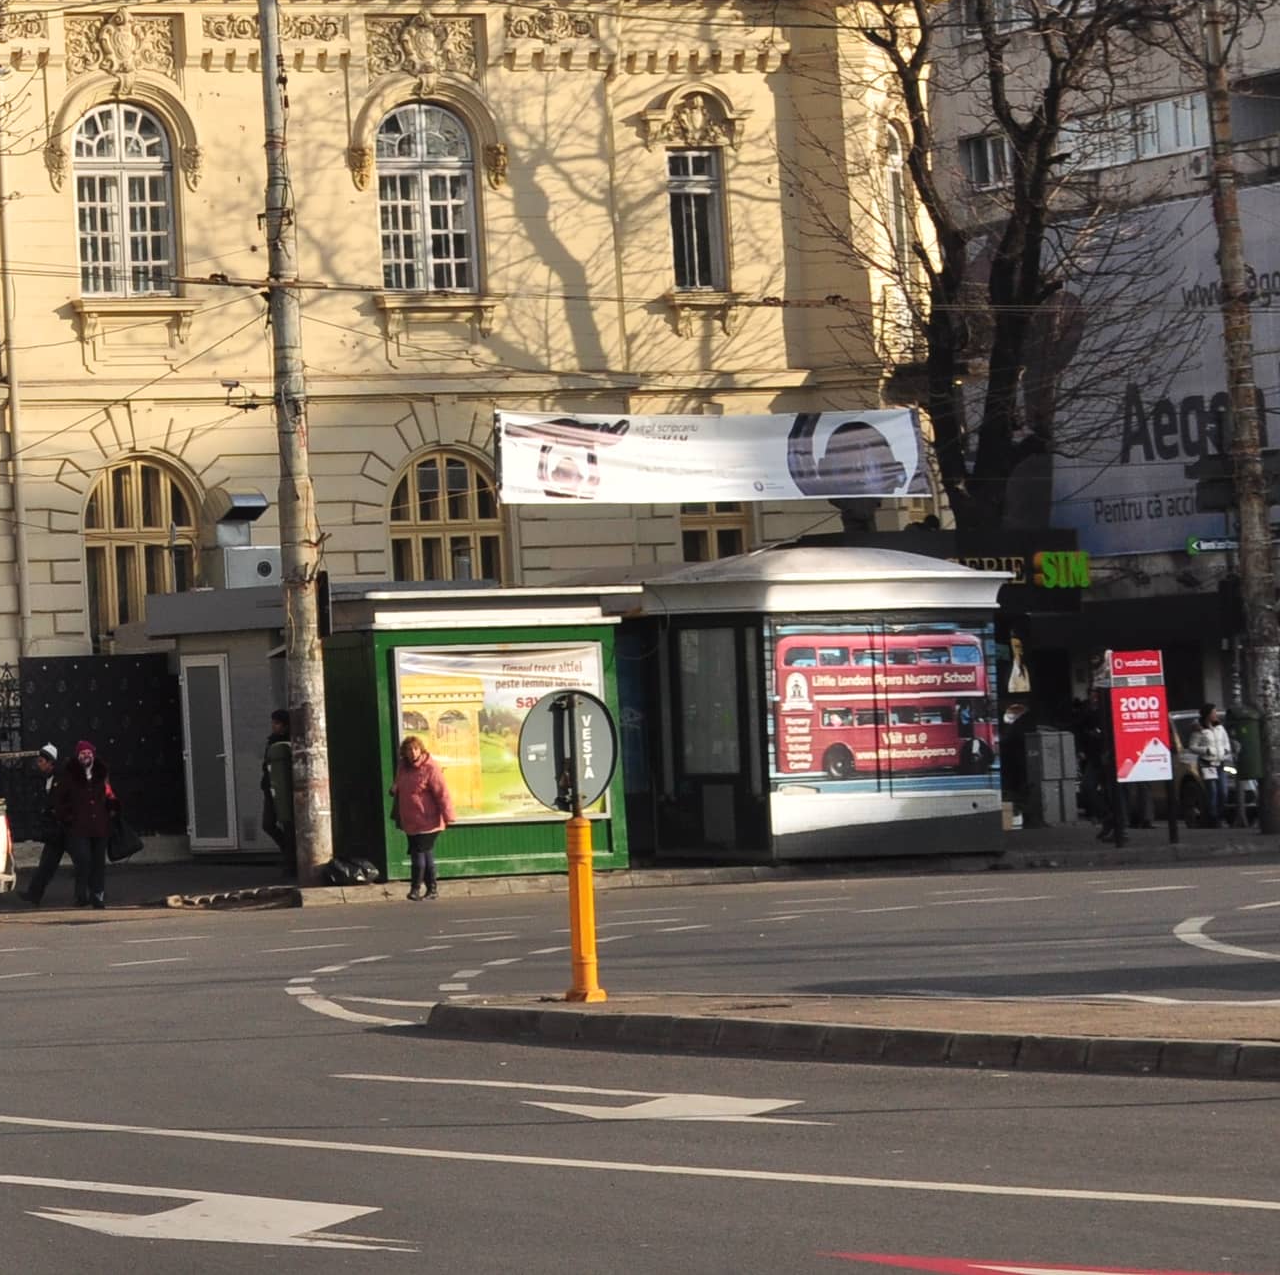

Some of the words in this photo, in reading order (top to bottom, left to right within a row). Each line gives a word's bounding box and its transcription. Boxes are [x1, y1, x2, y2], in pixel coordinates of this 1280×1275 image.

[1120, 382, 1269, 464] Aego
[1093, 497, 1142, 524] Pentru
[1146, 495, 1163, 519] că
[1167, 494, 1197, 517] acci
[1034, 551, 1090, 588] SIM
[534, 663, 556, 673] trece
[557, 660, 582, 673] altfel
[1125, 659, 1158, 667] vodafone
[495, 679, 520, 692] peste
[812, 675, 836, 687] Little
[837, 674, 873, 686] London
[874, 674, 903, 688] Pipera
[905, 673, 941, 686] Nursery
[943, 671, 976, 684] School
[1120, 696, 1160, 712] 2000
[581, 715, 594, 779] VESTA
[904, 734, 917, 744] us
